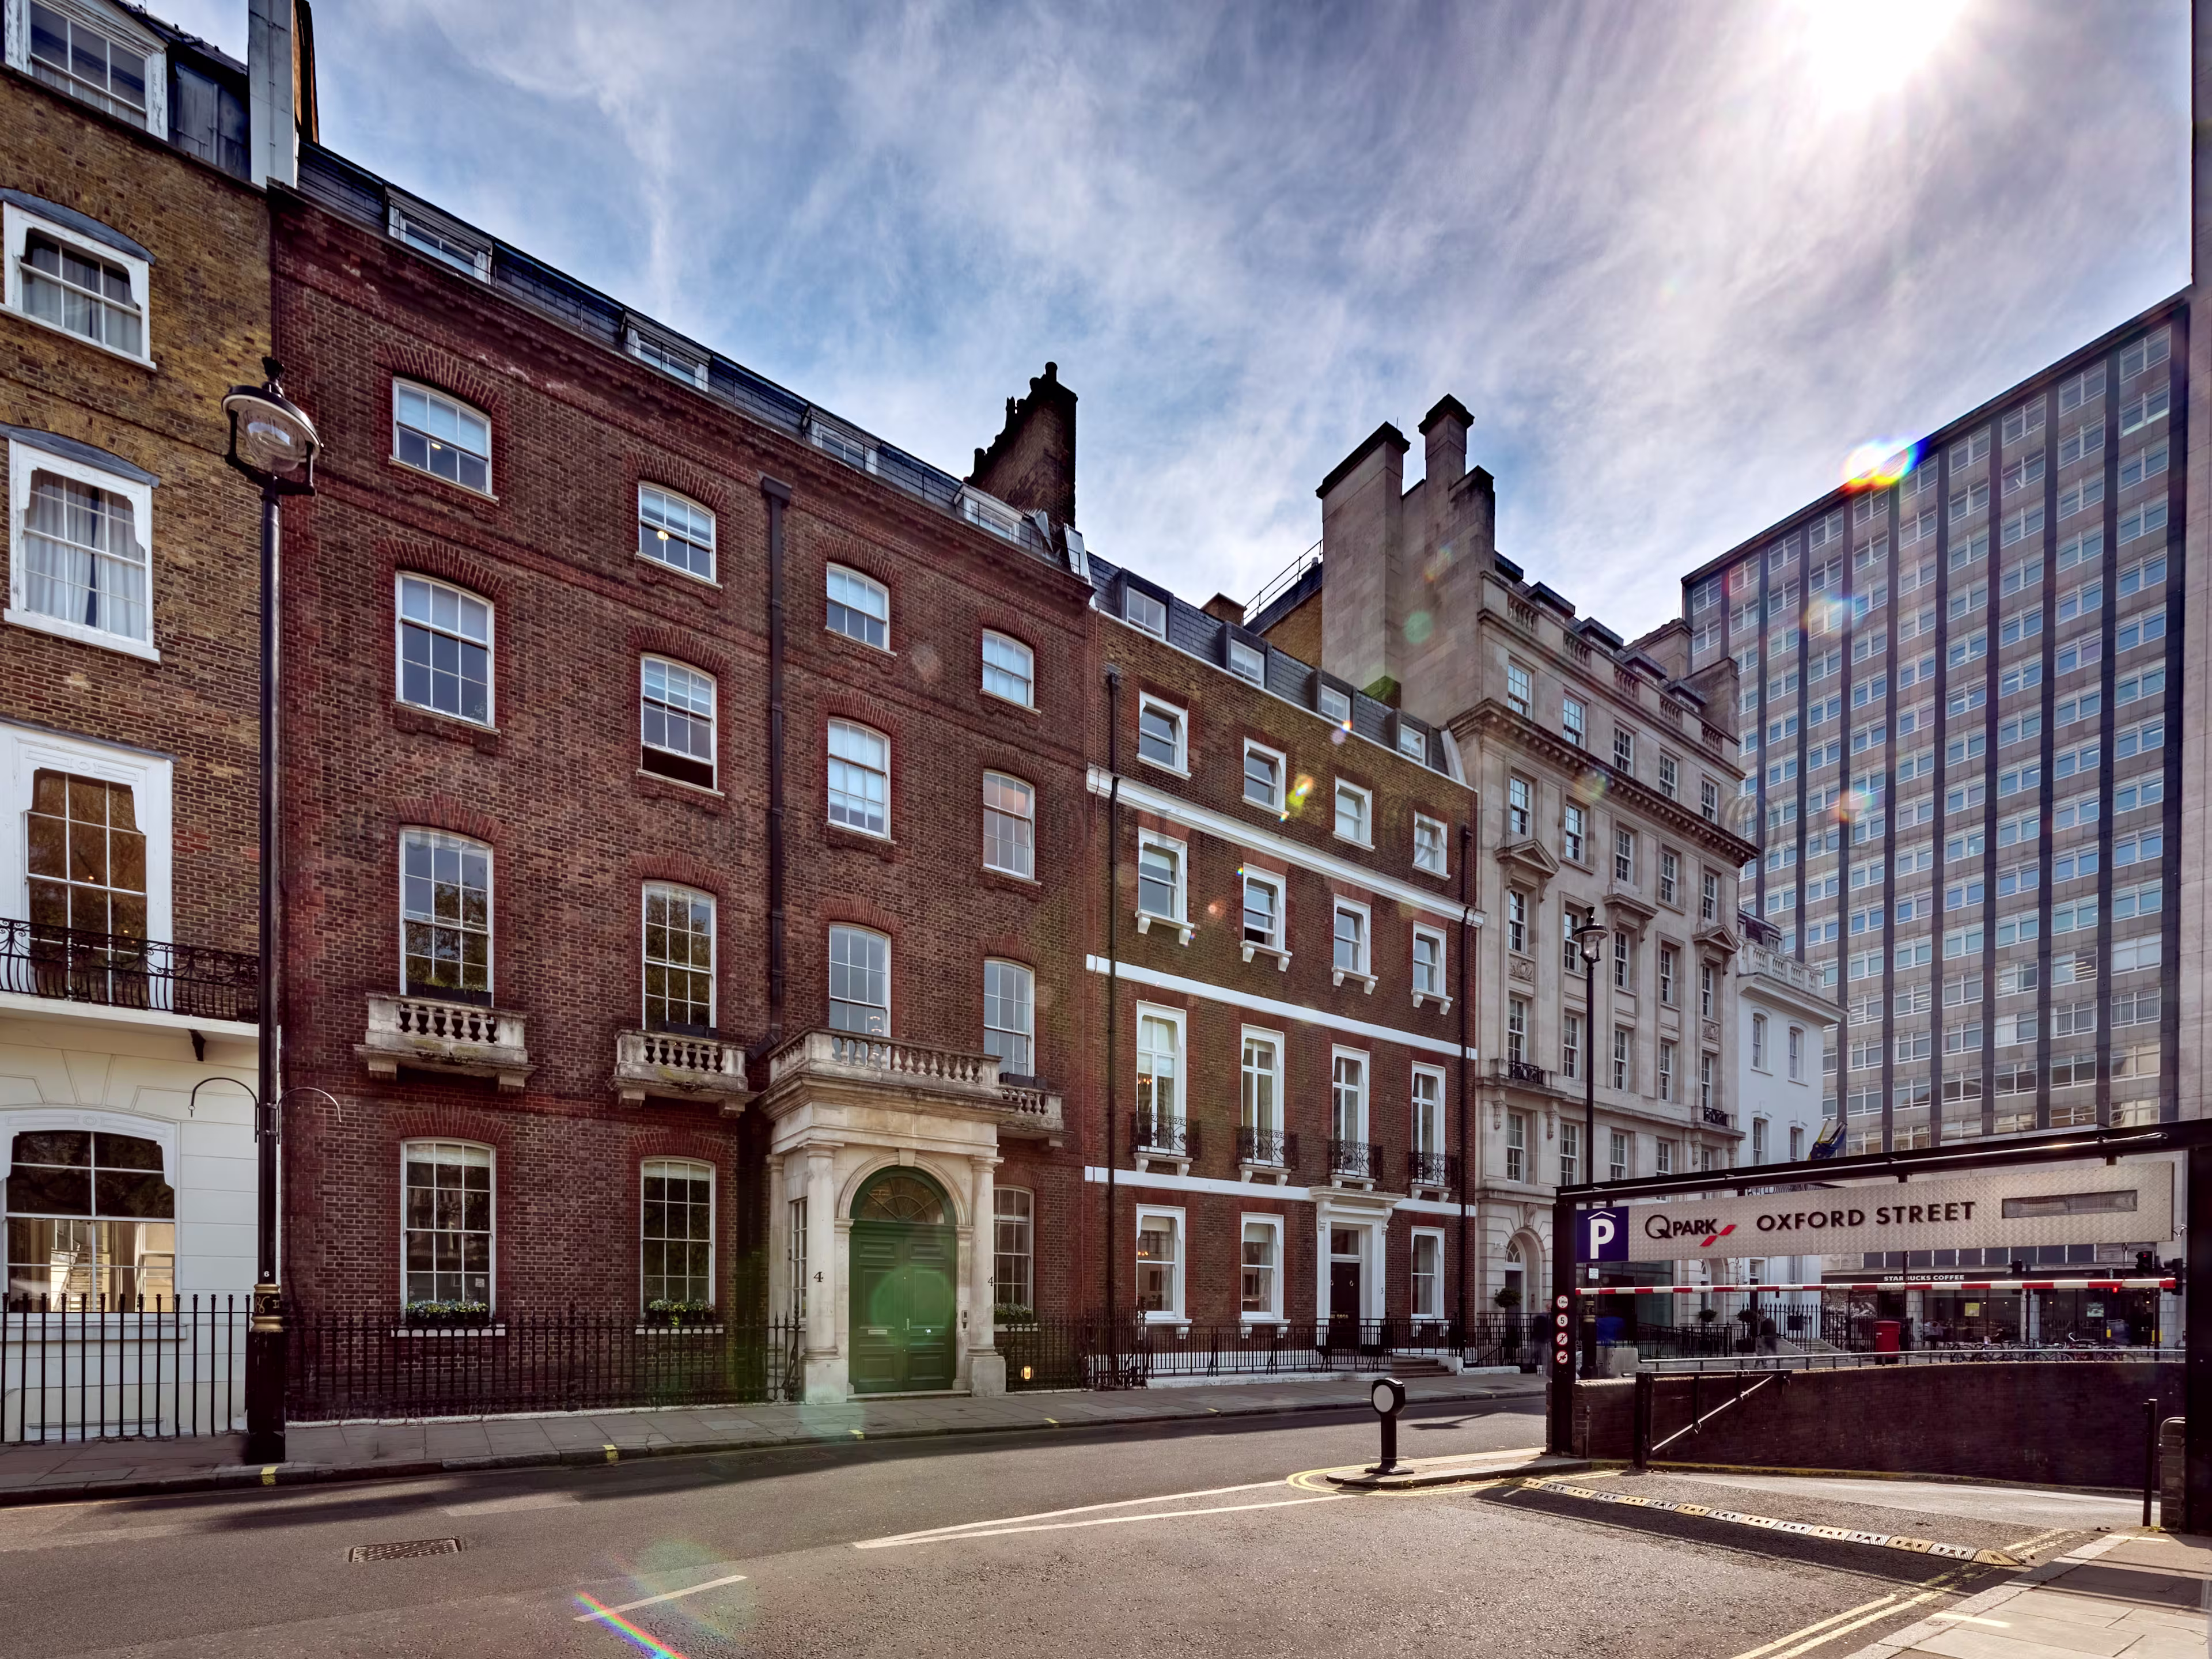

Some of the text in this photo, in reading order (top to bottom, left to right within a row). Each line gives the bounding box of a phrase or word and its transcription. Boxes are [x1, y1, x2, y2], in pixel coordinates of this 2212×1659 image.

[1756, 1202, 1976, 1231] OXFORD STREET
[1590, 1218, 1615, 1259] P
[813, 1271, 823, 1282] 4
[987, 1277, 993, 1286] 4
